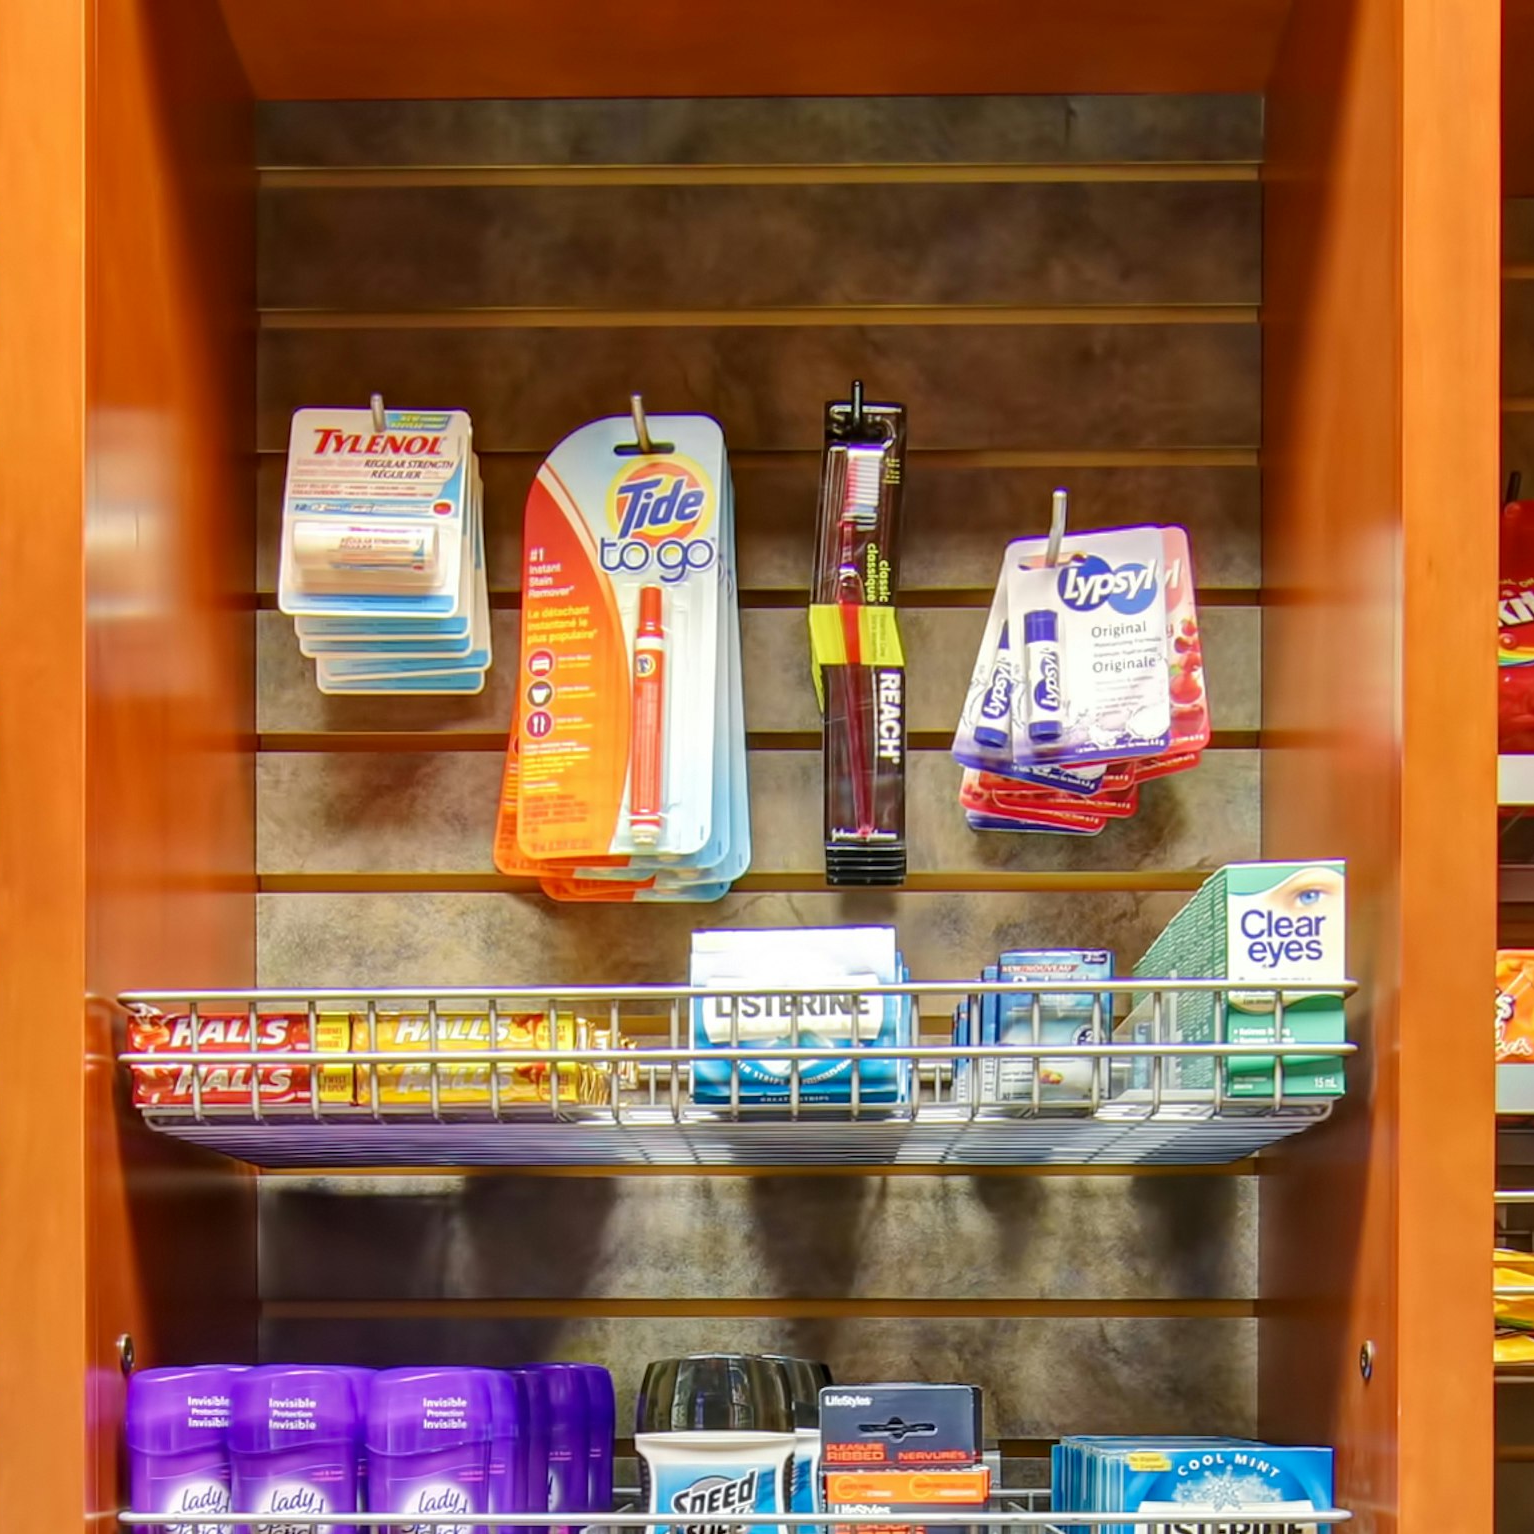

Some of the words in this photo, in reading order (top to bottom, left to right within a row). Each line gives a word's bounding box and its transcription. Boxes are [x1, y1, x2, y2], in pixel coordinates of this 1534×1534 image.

[314, 428, 444, 455] TYLENOL
[364, 459, 407, 470] REGULAR
[408, 459, 454, 470] STRENGTH
[371, 468, 422, 480] RÉGULIER
[616, 477, 704, 538] Tide
[529, 563, 562, 575] Instant
[599, 536, 650, 572] to
[656, 539, 715, 582] go
[529, 576, 554, 587] Stain
[879, 558, 891, 604] classic
[1061, 558, 1157, 605] Lypsyl
[1091, 621, 1147, 638] Original
[1092, 656, 1157, 673] Originale
[1039, 648, 1060, 711] Lypsyl
[877, 671, 901, 762] REACH
[1240, 909, 1326, 939] Clear
[1248, 938, 1323, 968] eyes
[170, 1018, 290, 1047] HALLS
[394, 1016, 512, 1044] HALLS
[173, 1068, 292, 1094] HALLS
[269, 1397, 317, 1410] Invisible
[423, 1397, 468, 1410] Invisible
[825, 1394, 873, 1409] LifeStyles
[269, 1418, 317, 1430] Invisible
[423, 1418, 468, 1430] Invisible
[826, 1450, 886, 1462] RIBBED
[1177, 1453, 1225, 1477] COOL
[1234, 1453, 1281, 1479] MINT
[181, 1485, 225, 1514] lady
[269, 1483, 314, 1517] lady
[417, 1484, 461, 1516] lady
[673, 1469, 758, 1515] SPEED
